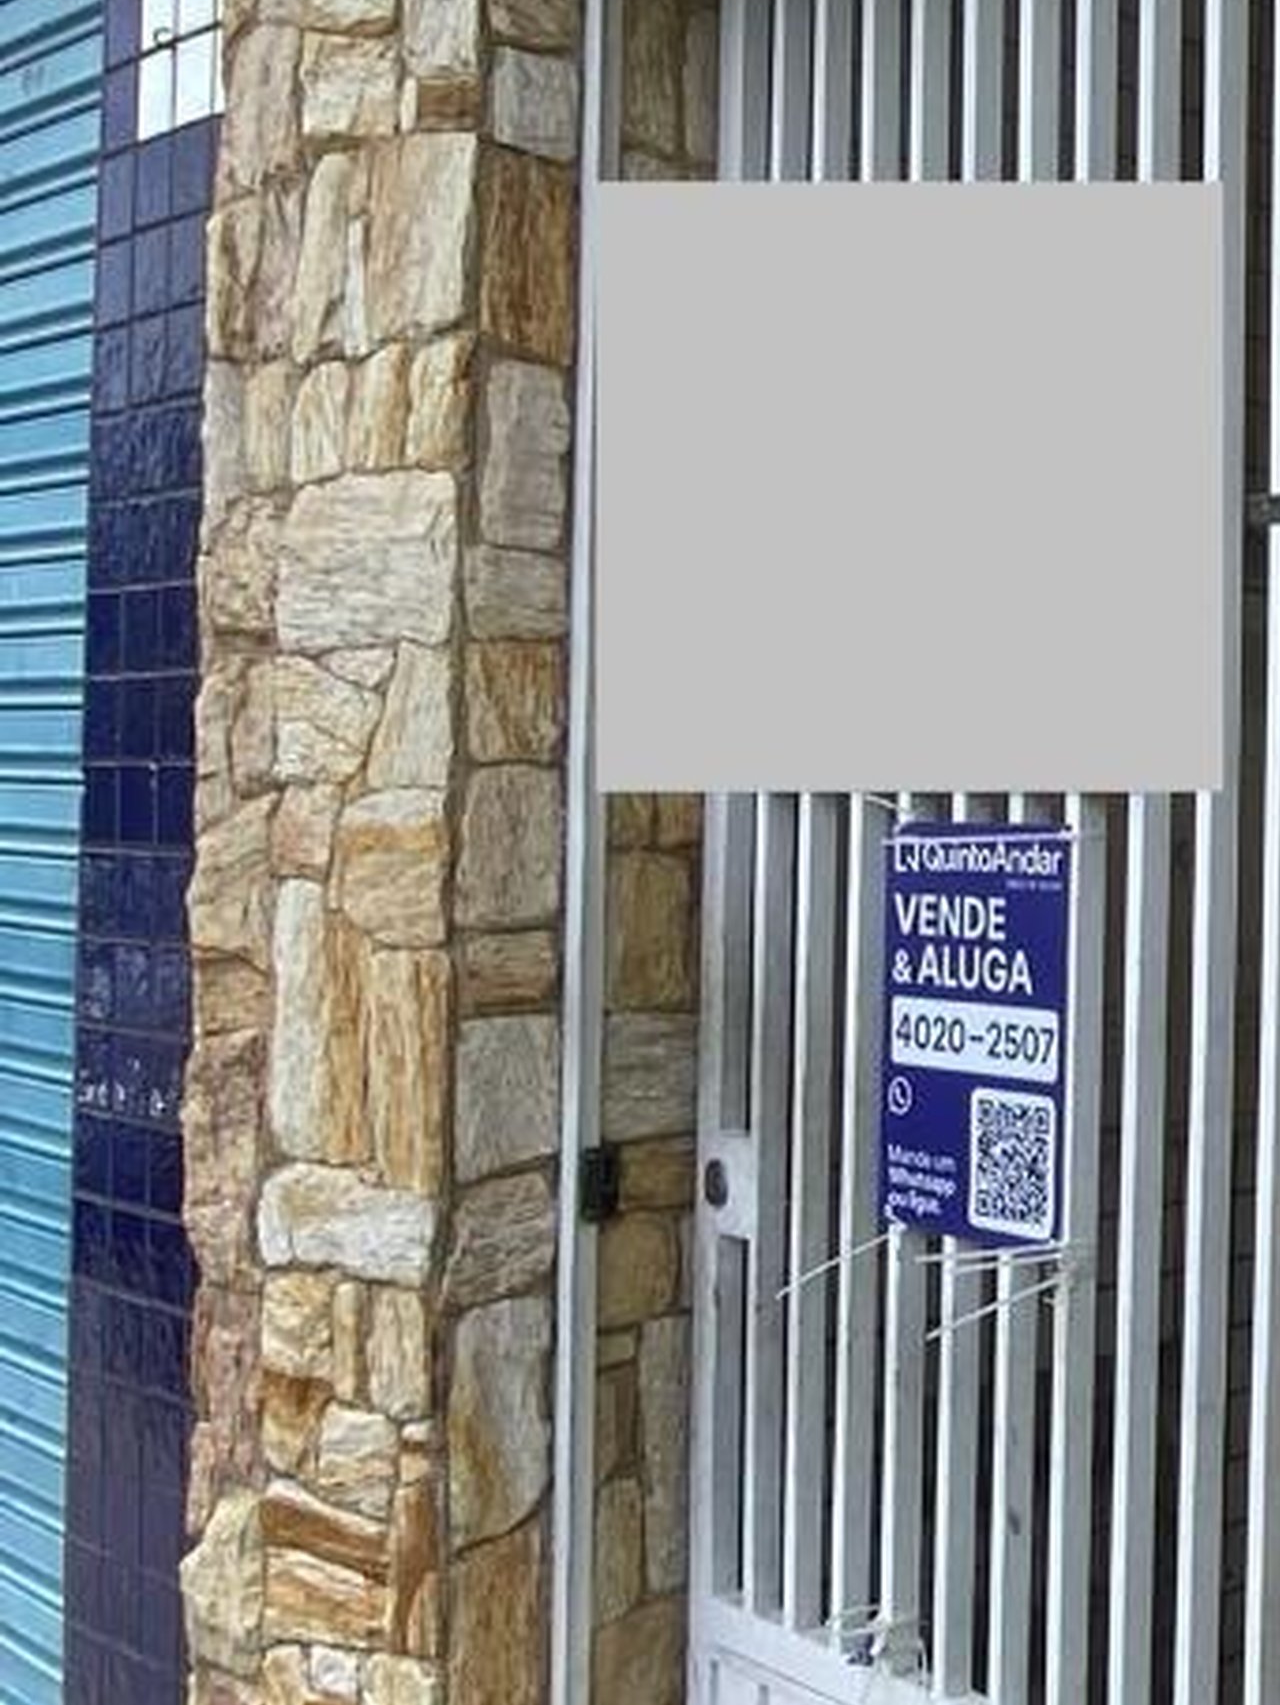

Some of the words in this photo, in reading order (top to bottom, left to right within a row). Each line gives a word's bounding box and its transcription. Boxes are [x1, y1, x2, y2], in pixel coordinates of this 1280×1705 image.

[921, 842, 1063, 875] QuintoAndar
[894, 892, 1007, 941] VENDE
[891, 947, 912, 985] &
[916, 944, 1033, 995] ALUGA
[895, 1012, 1056, 1066] 4020-2507
